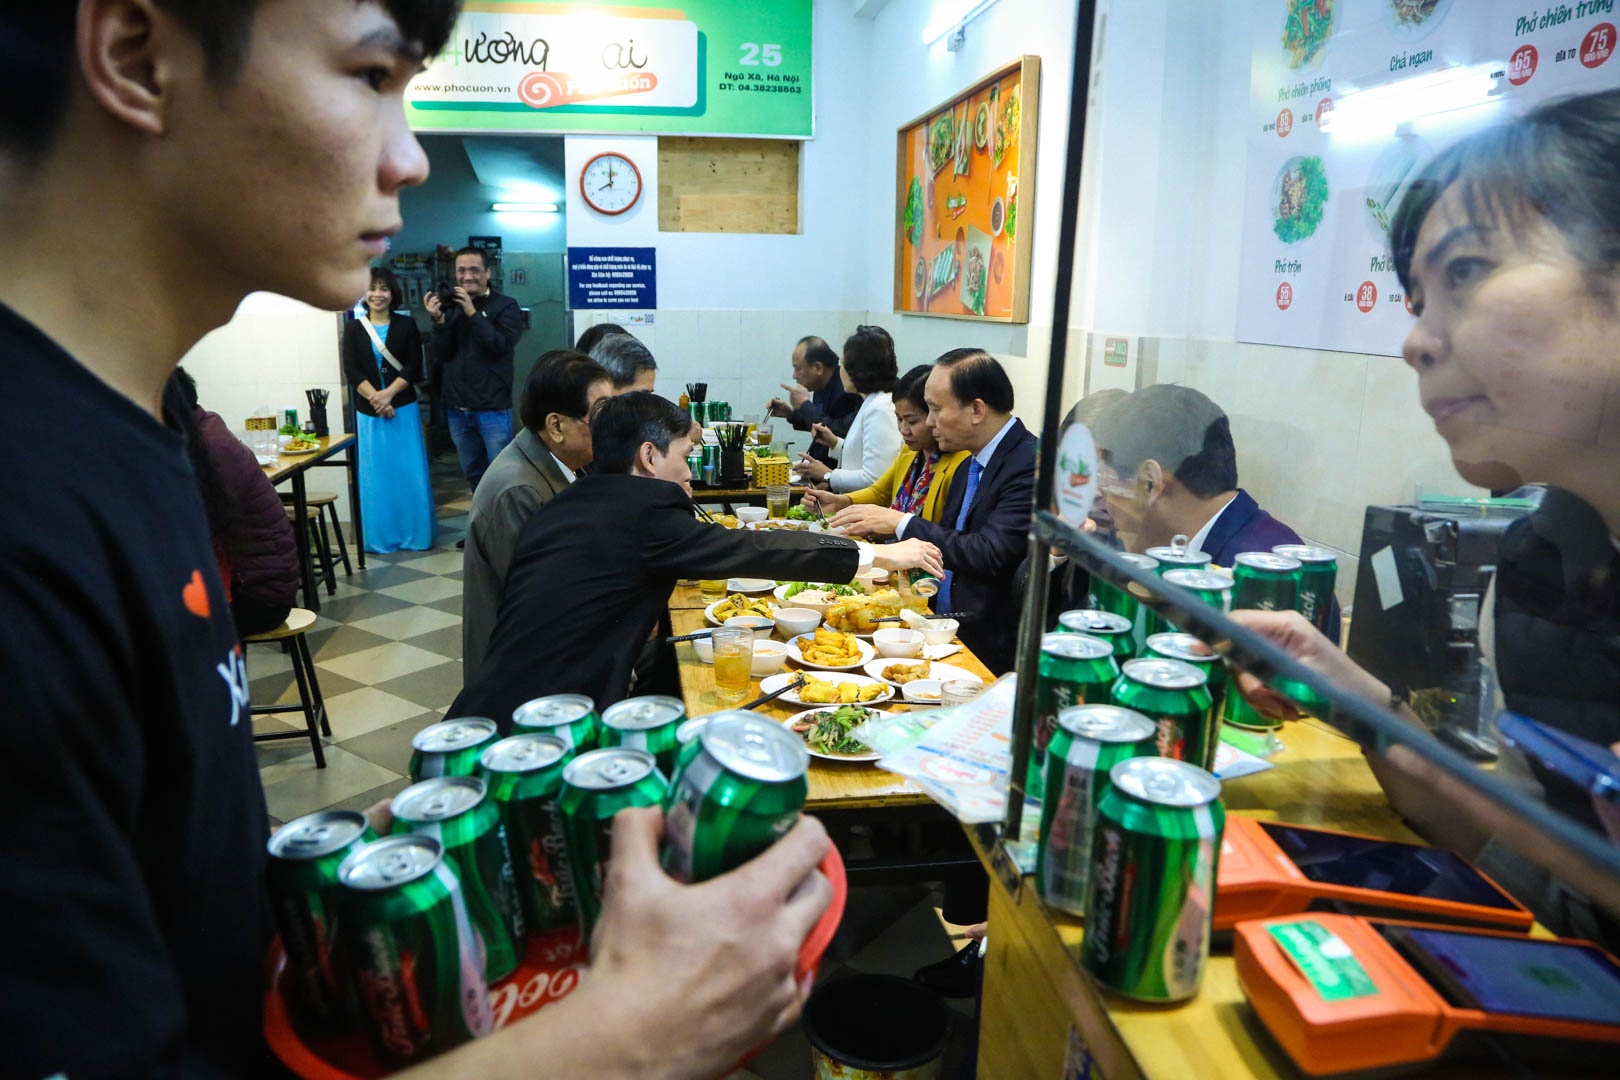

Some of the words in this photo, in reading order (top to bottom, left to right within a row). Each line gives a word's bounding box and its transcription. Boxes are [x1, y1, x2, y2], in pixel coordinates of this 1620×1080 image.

[1588, 29, 1608, 53] 75
[602, 39, 648, 70] ai
[739, 42, 782, 67] 25
[1408, 49, 1433, 68] ngan
[1515, 50, 1531, 71] 65
[413, 83, 511, 94] www.phocuon.vn
[1279, 111, 1290, 127] 65
[1280, 286, 1290, 299] 55
[1361, 285, 1373, 300] 38
[1117, 343, 1126, 354] NO
